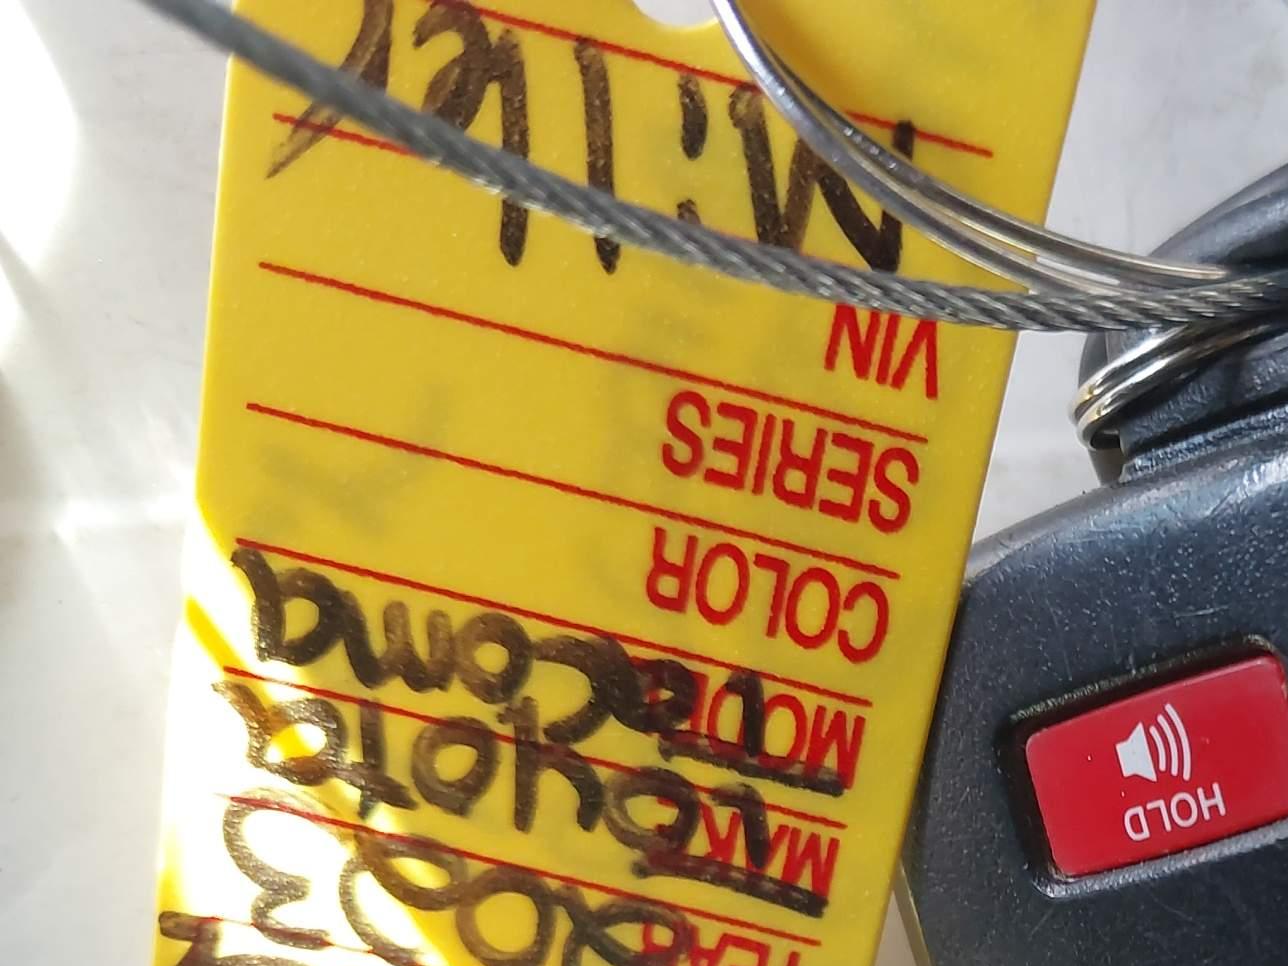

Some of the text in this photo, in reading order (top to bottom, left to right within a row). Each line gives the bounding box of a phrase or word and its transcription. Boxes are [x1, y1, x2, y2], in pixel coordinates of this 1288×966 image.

[826, 302, 941, 398] VIN
[662, 389, 921, 534] SERIES
[646, 526, 890, 664] COLOR
[212, 680, 829, 918] Toyota
[1124, 781, 1227, 842] HOLD
